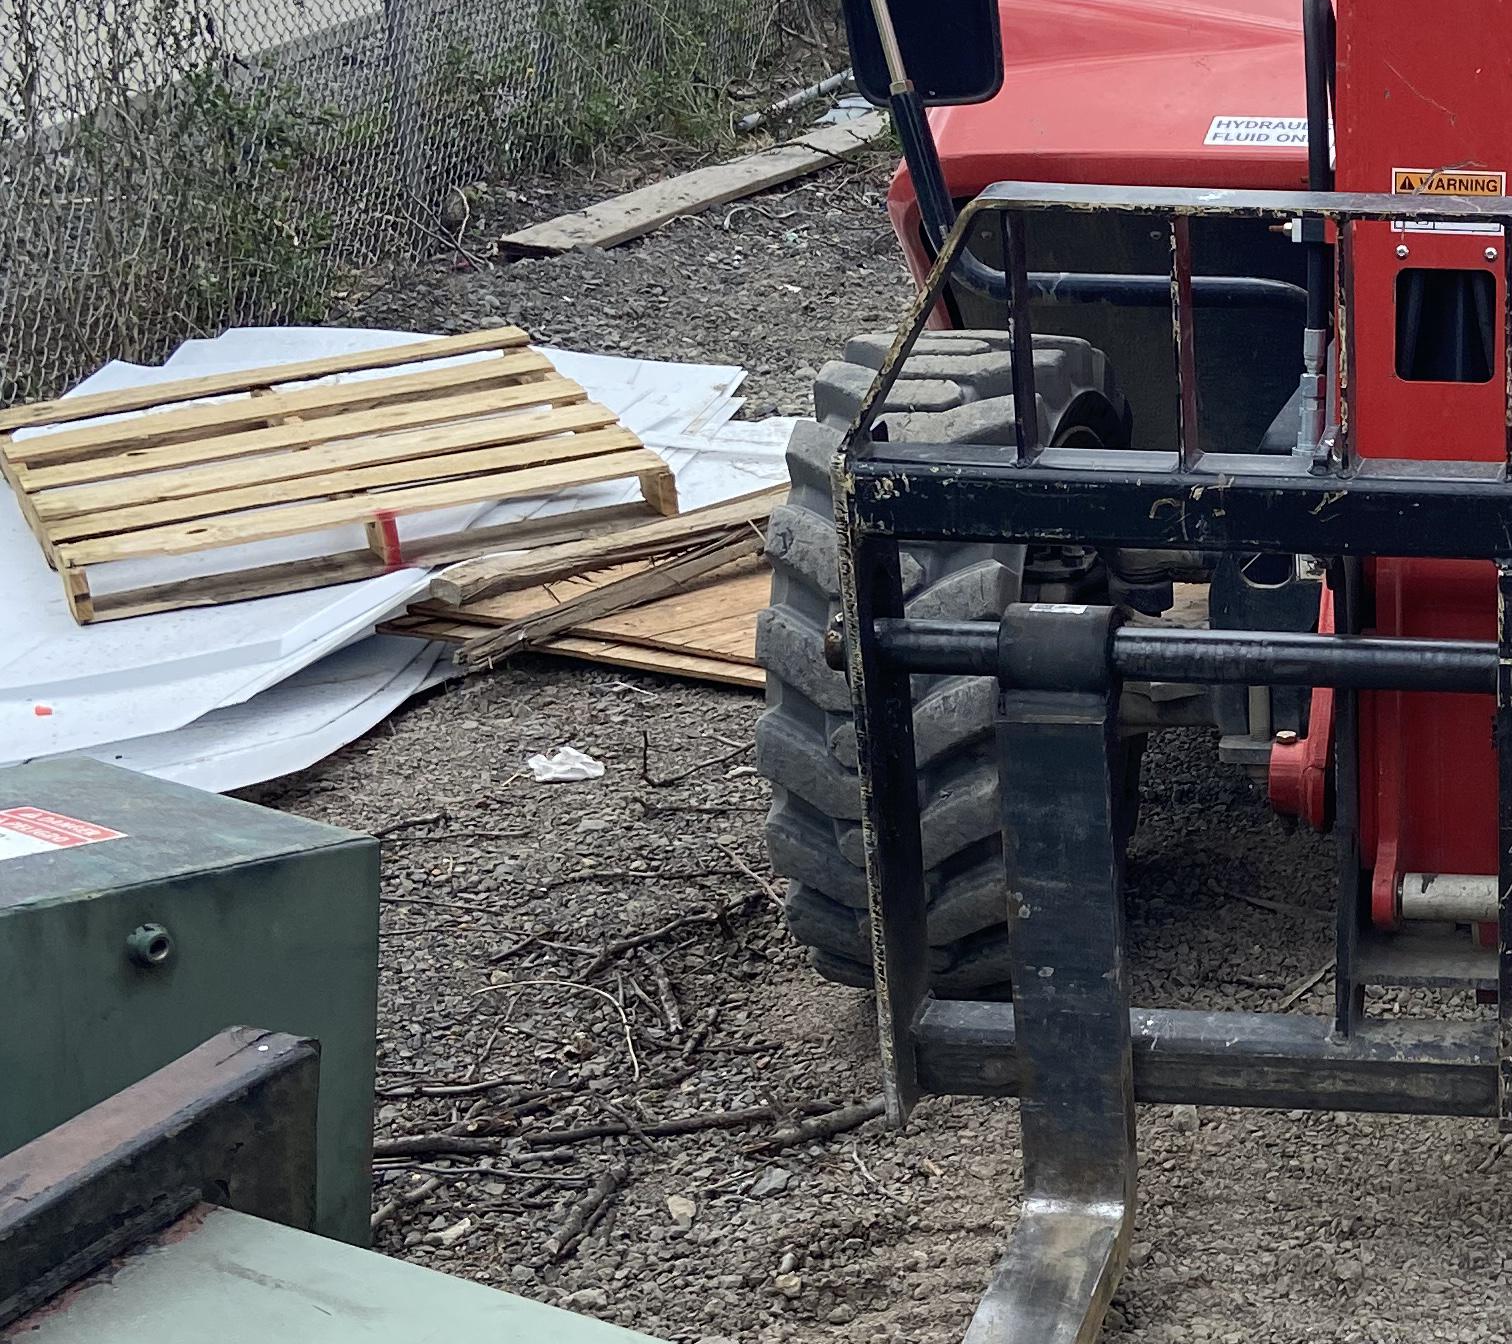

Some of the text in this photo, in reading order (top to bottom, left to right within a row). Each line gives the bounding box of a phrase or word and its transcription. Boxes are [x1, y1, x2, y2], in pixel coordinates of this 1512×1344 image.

[1216, 119, 1309, 130] HYDRAUL
[1211, 132, 1309, 143] FLUID ON
[1420, 176, 1498, 193] WARNING
